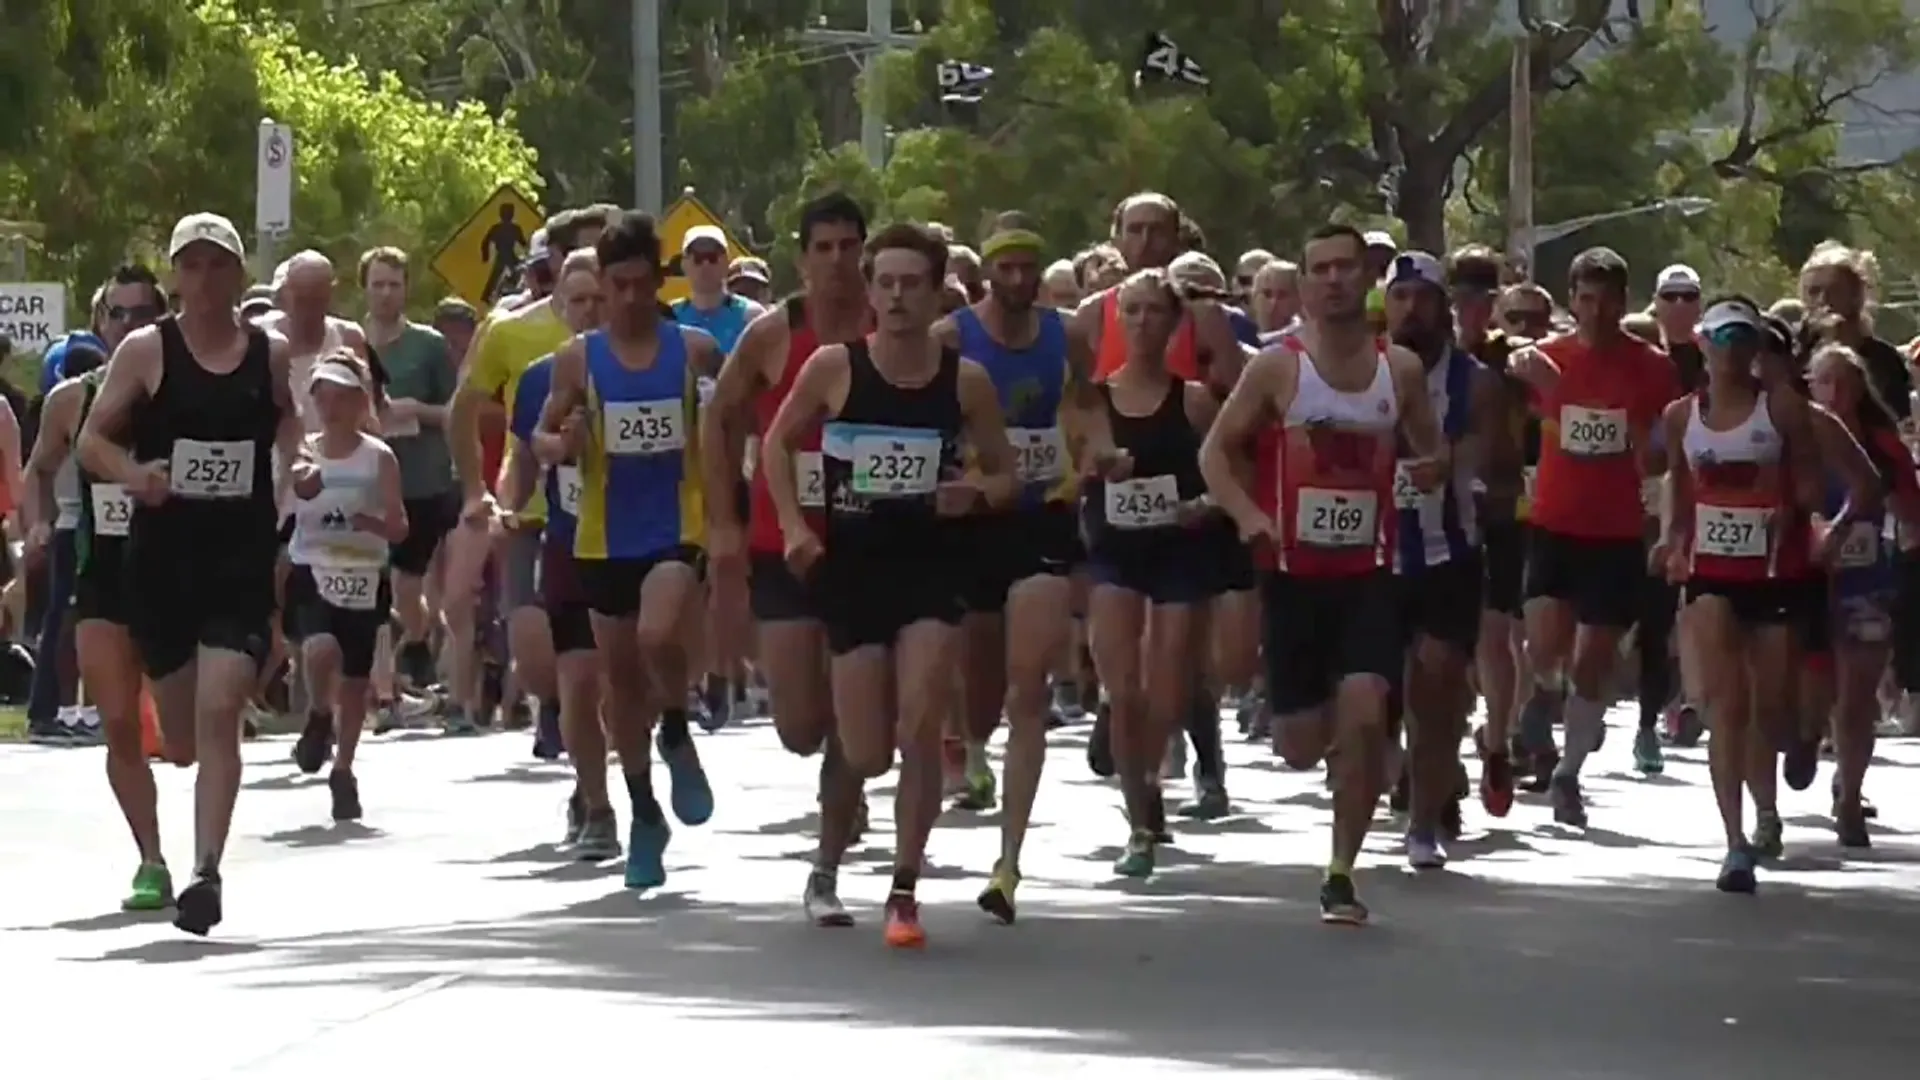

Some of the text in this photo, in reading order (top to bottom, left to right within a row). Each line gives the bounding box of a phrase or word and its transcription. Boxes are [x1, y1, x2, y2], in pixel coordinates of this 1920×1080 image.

[0, 295, 44, 315] CAR
[0, 322, 50, 341] ARK
[619, 416, 673, 440] 2435
[1570, 420, 1617, 442] 2009
[185, 458, 241, 483] 2527
[869, 455, 926, 480] 2327
[1116, 492, 1168, 516] 2434
[1312, 507, 1362, 531] 2169
[1707, 521, 1754, 544] 2237
[323, 575, 369, 597] 2032
